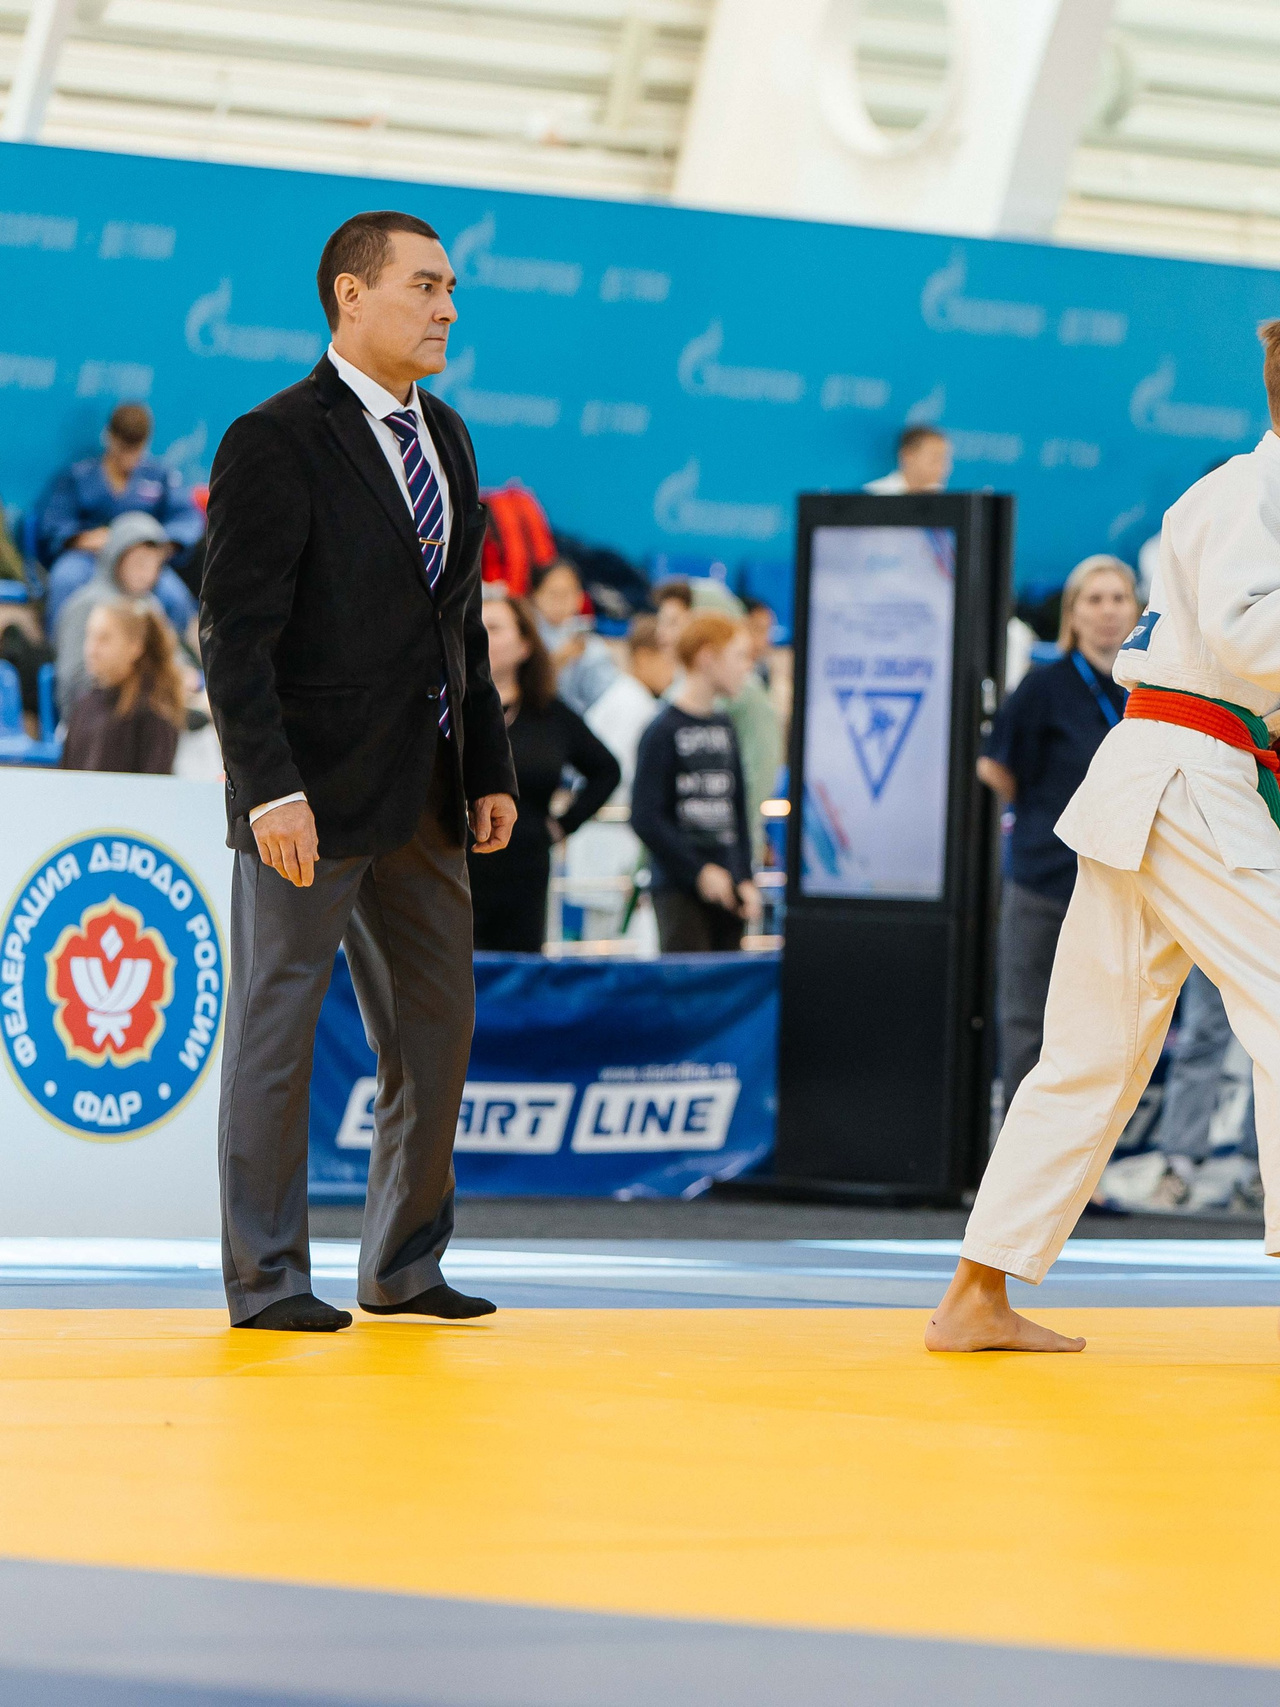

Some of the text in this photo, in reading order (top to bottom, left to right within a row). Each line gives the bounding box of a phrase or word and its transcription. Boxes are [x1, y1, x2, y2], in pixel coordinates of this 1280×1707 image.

[1, 841, 219, 1071] ФЕДЕРАЦИЯ ДЗЮДО РОССИИ
[72, 1090, 142, 1126] ФДР
[592, 1096, 714, 1136] LINE
